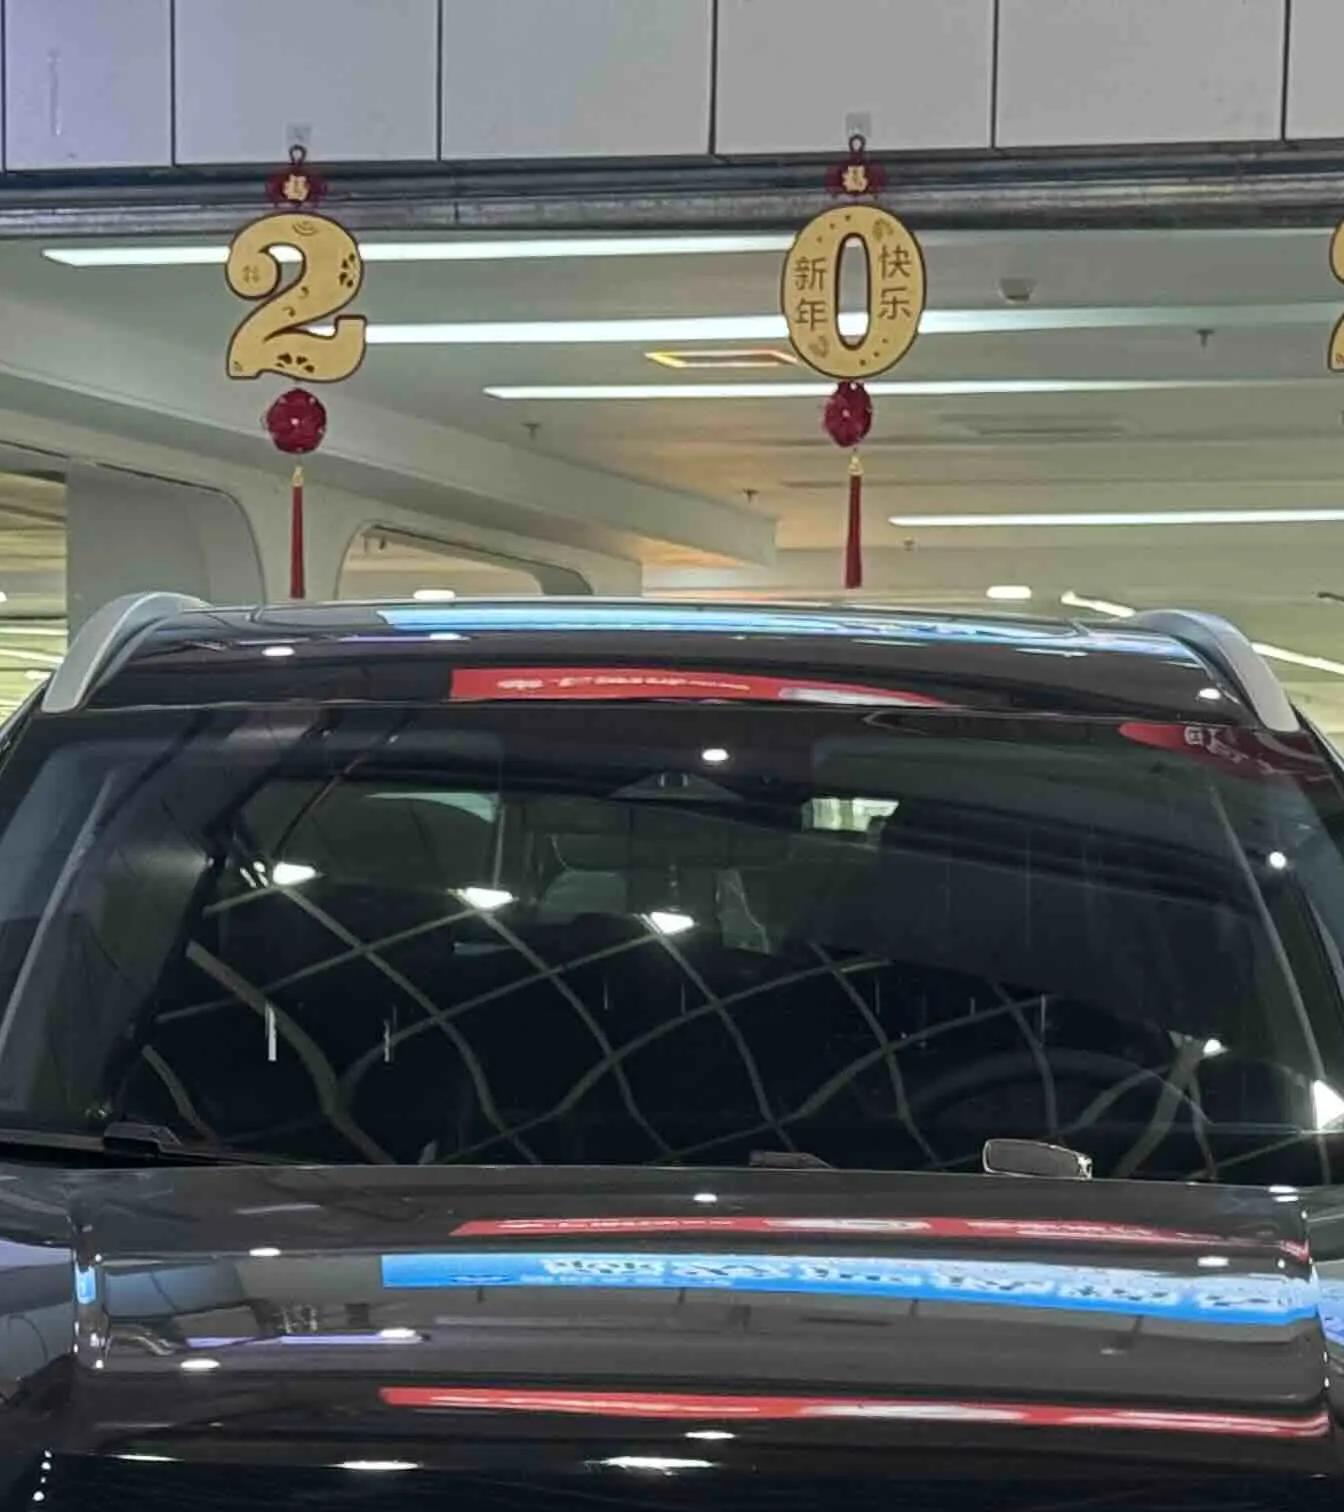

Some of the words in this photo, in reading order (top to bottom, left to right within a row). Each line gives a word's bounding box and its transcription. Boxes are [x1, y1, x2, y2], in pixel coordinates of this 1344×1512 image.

[225, 211, 367, 384] 2
[780, 204, 927, 380] 0
[793, 256, 829, 332] 新年
[877, 244, 913, 321] 快乐
